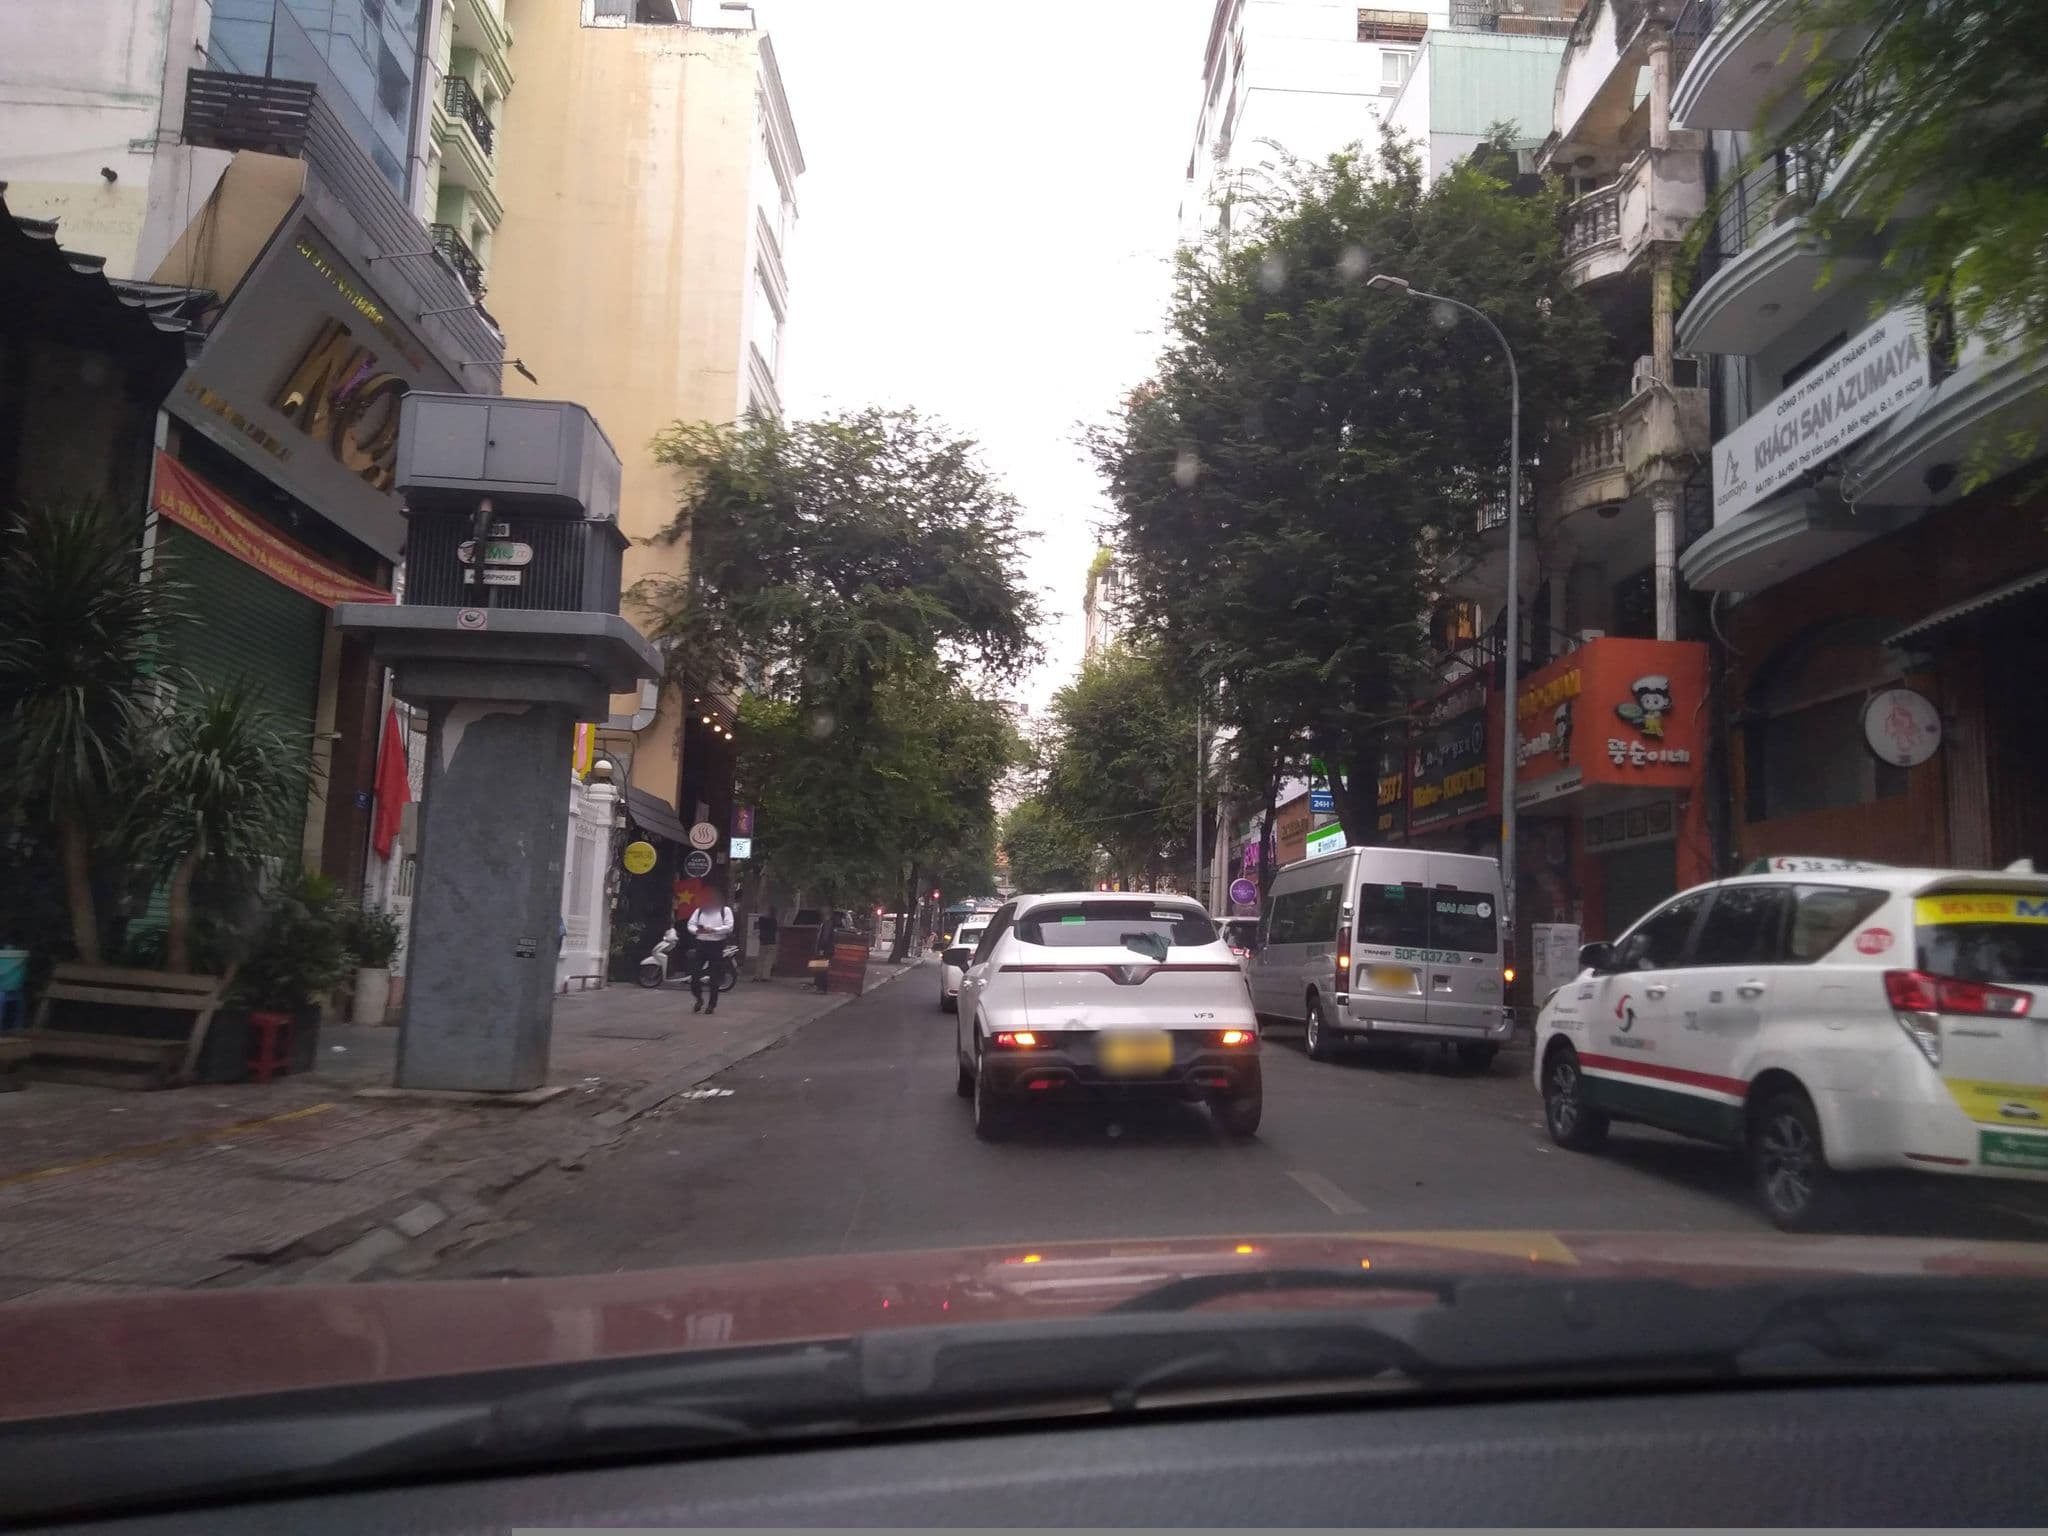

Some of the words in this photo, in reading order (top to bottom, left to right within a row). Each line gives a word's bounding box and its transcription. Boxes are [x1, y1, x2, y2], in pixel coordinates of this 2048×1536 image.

[1754, 418, 1799, 473] KHÁCH
[1800, 391, 1834, 440] SẠN
[1834, 334, 1920, 418] AZUMAYA
[1313, 799, 1330, 809] 24H
